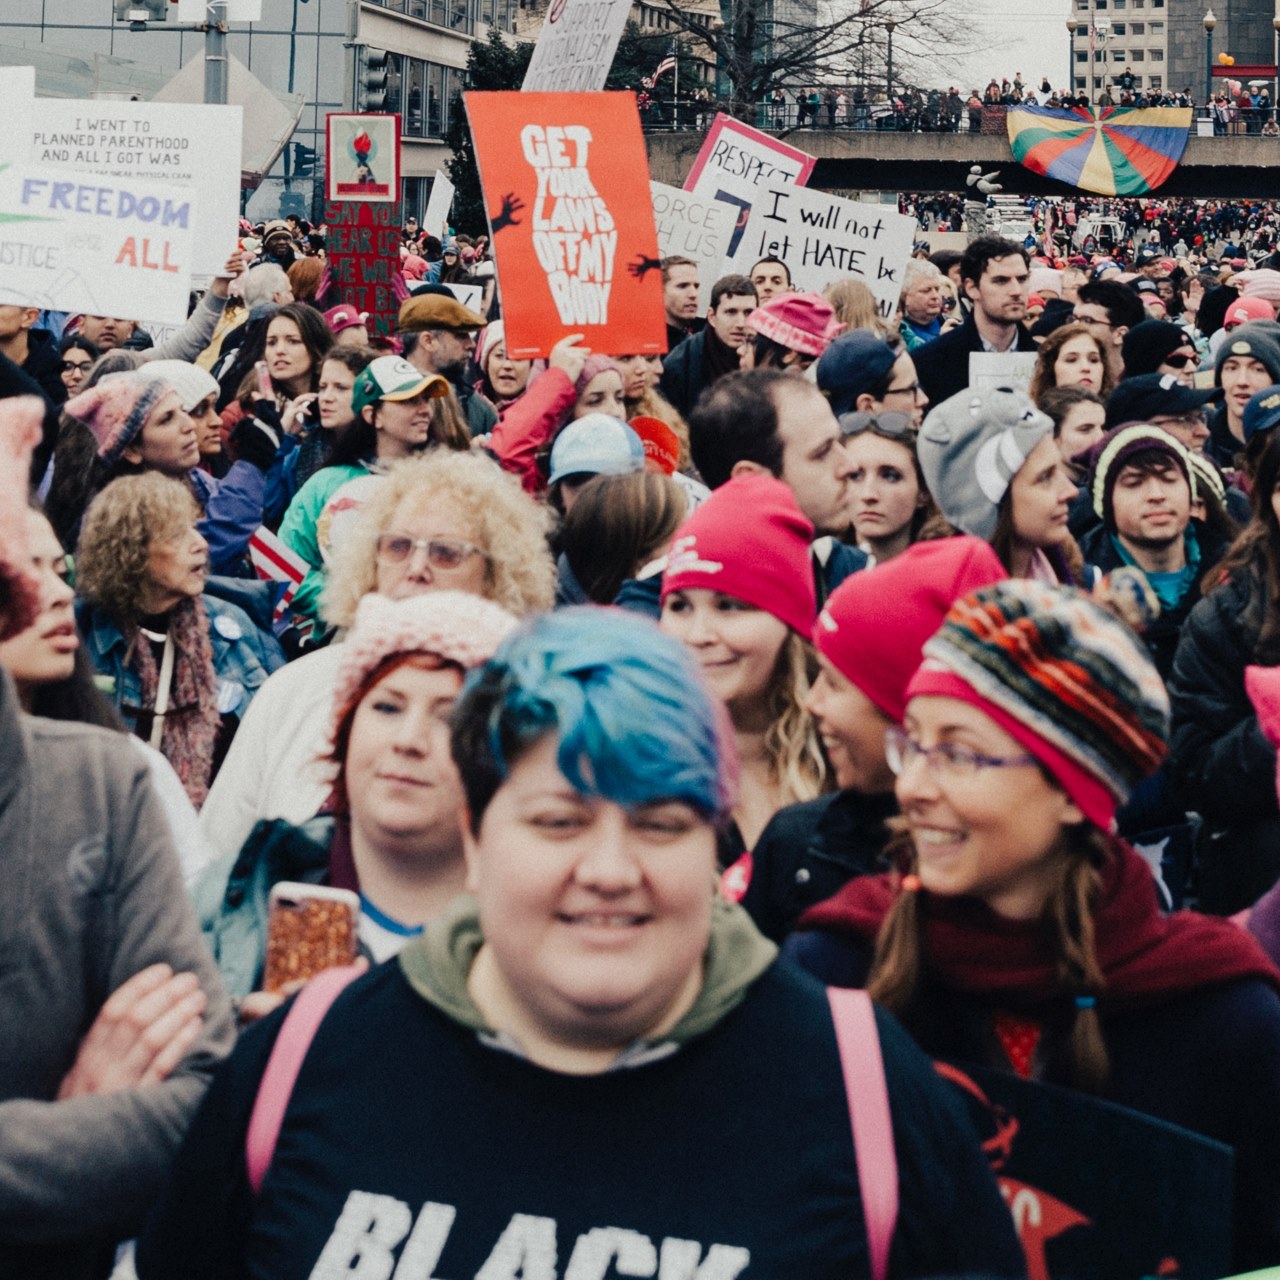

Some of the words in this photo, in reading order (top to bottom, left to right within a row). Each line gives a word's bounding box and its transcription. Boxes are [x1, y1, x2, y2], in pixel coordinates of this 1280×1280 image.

[33, 132, 95, 147] PLANNED
[100, 135, 190, 150] PARENTHOOD
[75, 118, 82, 131] I
[87, 119, 127, 132] WENT
[133, 120, 151, 133] TO
[41, 149, 69, 162] AND
[75, 150, 100, 163] ALL
[105, 151, 112, 163] I
[116, 152, 144, 165] GOT
[149, 152, 181, 166] WAS
[520, 124, 593, 169] GET
[535, 166, 599, 199] YOUR
[21, 178, 191, 230] FREEDOM
[325, 200, 363, 226] SAY
[370, 200, 402, 226] YOU
[532, 195, 616, 234] LAWS
[653, 193, 721, 231] ORCE
[763, 189, 790, 224] I
[800, 205, 841, 231] will
[844, 218, 885, 240] not
[114, 235, 179, 273] ALL
[326, 228, 373, 254] HEAR
[376, 230, 402, 257] US
[532, 230, 581, 274] OFF
[580, 229, 618, 283] MY
[758, 229, 793, 259] let
[801, 236, 866, 275] HATE
[877, 256, 900, 283] be
[547, 269, 612, 326] BODY
[308, 1188, 751, 1280] BLACK
